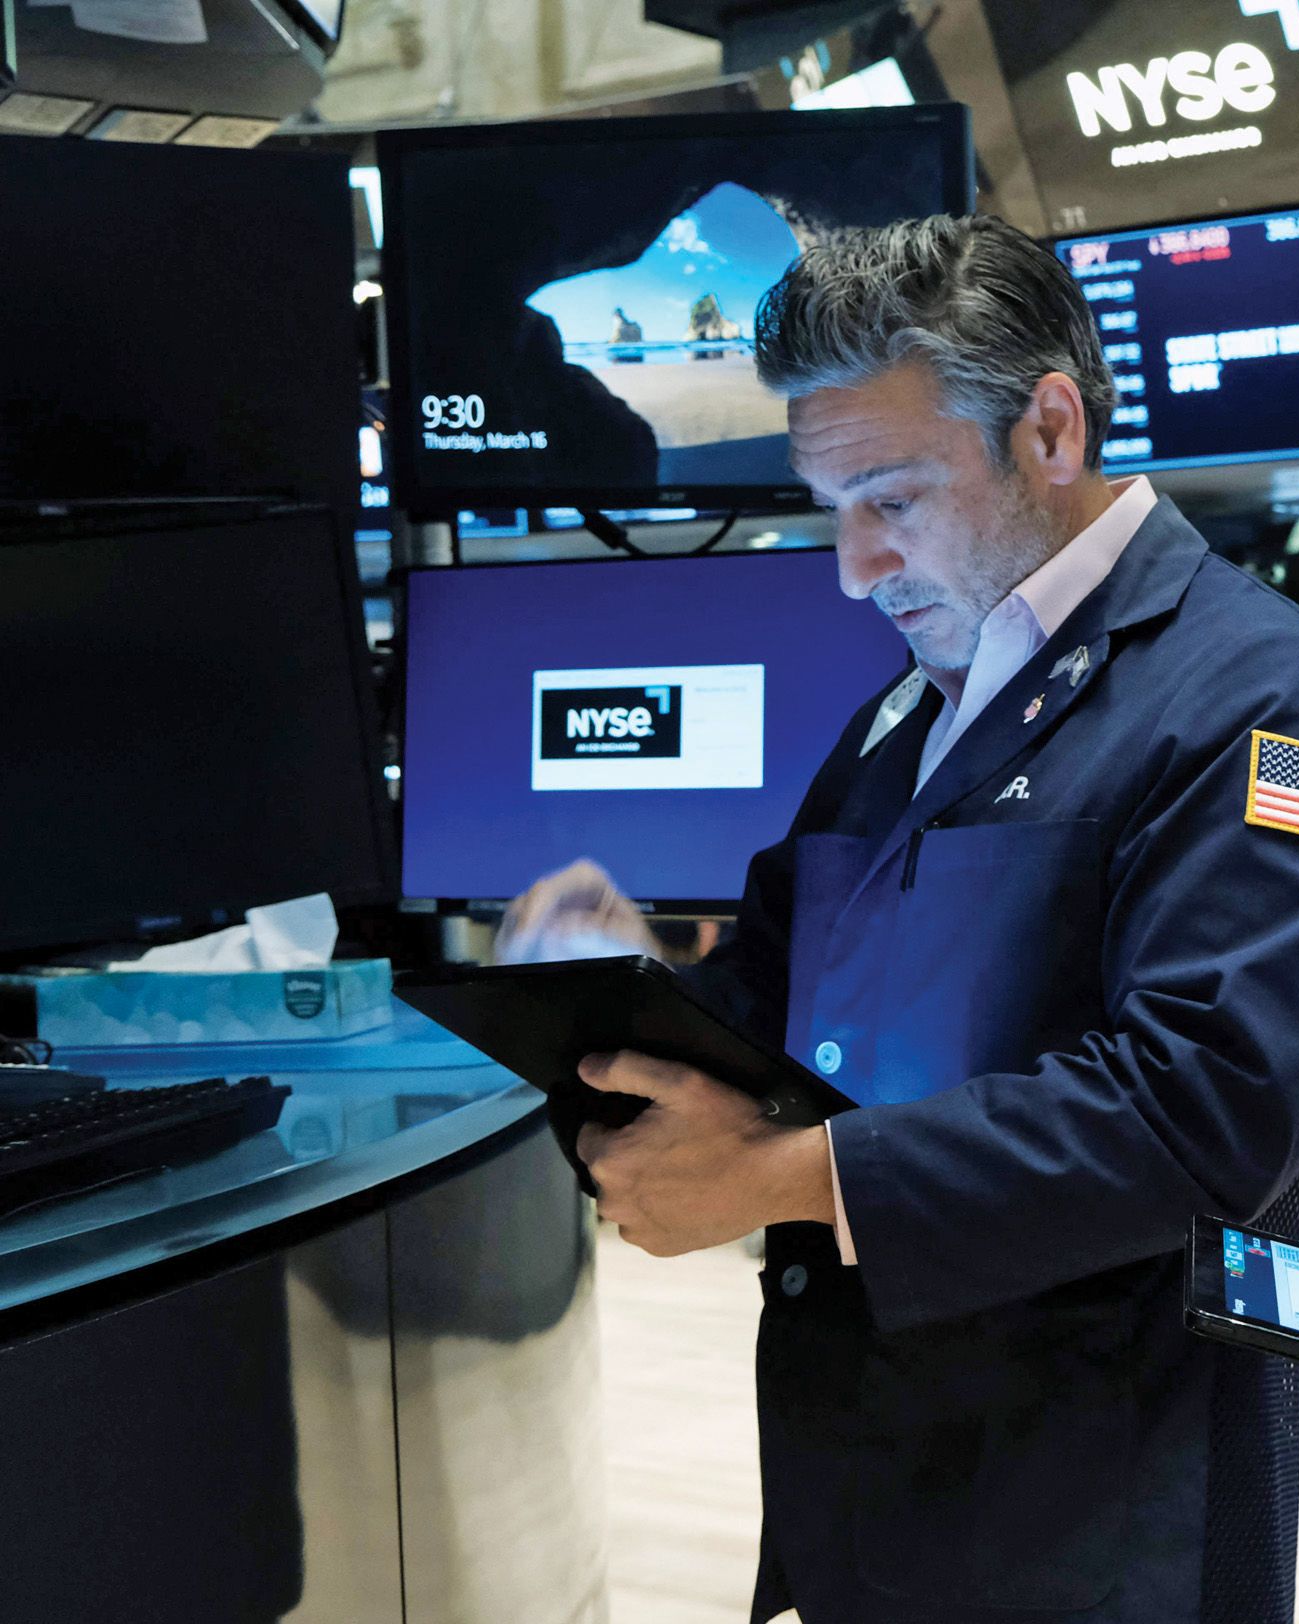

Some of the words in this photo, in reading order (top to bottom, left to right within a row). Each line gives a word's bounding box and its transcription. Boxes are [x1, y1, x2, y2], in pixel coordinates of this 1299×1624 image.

[421, 394, 485, 429] 9:30
[423, 431, 486, 453] Thursday,
[487, 431, 530, 449] March
[531, 431, 548, 449] 16
